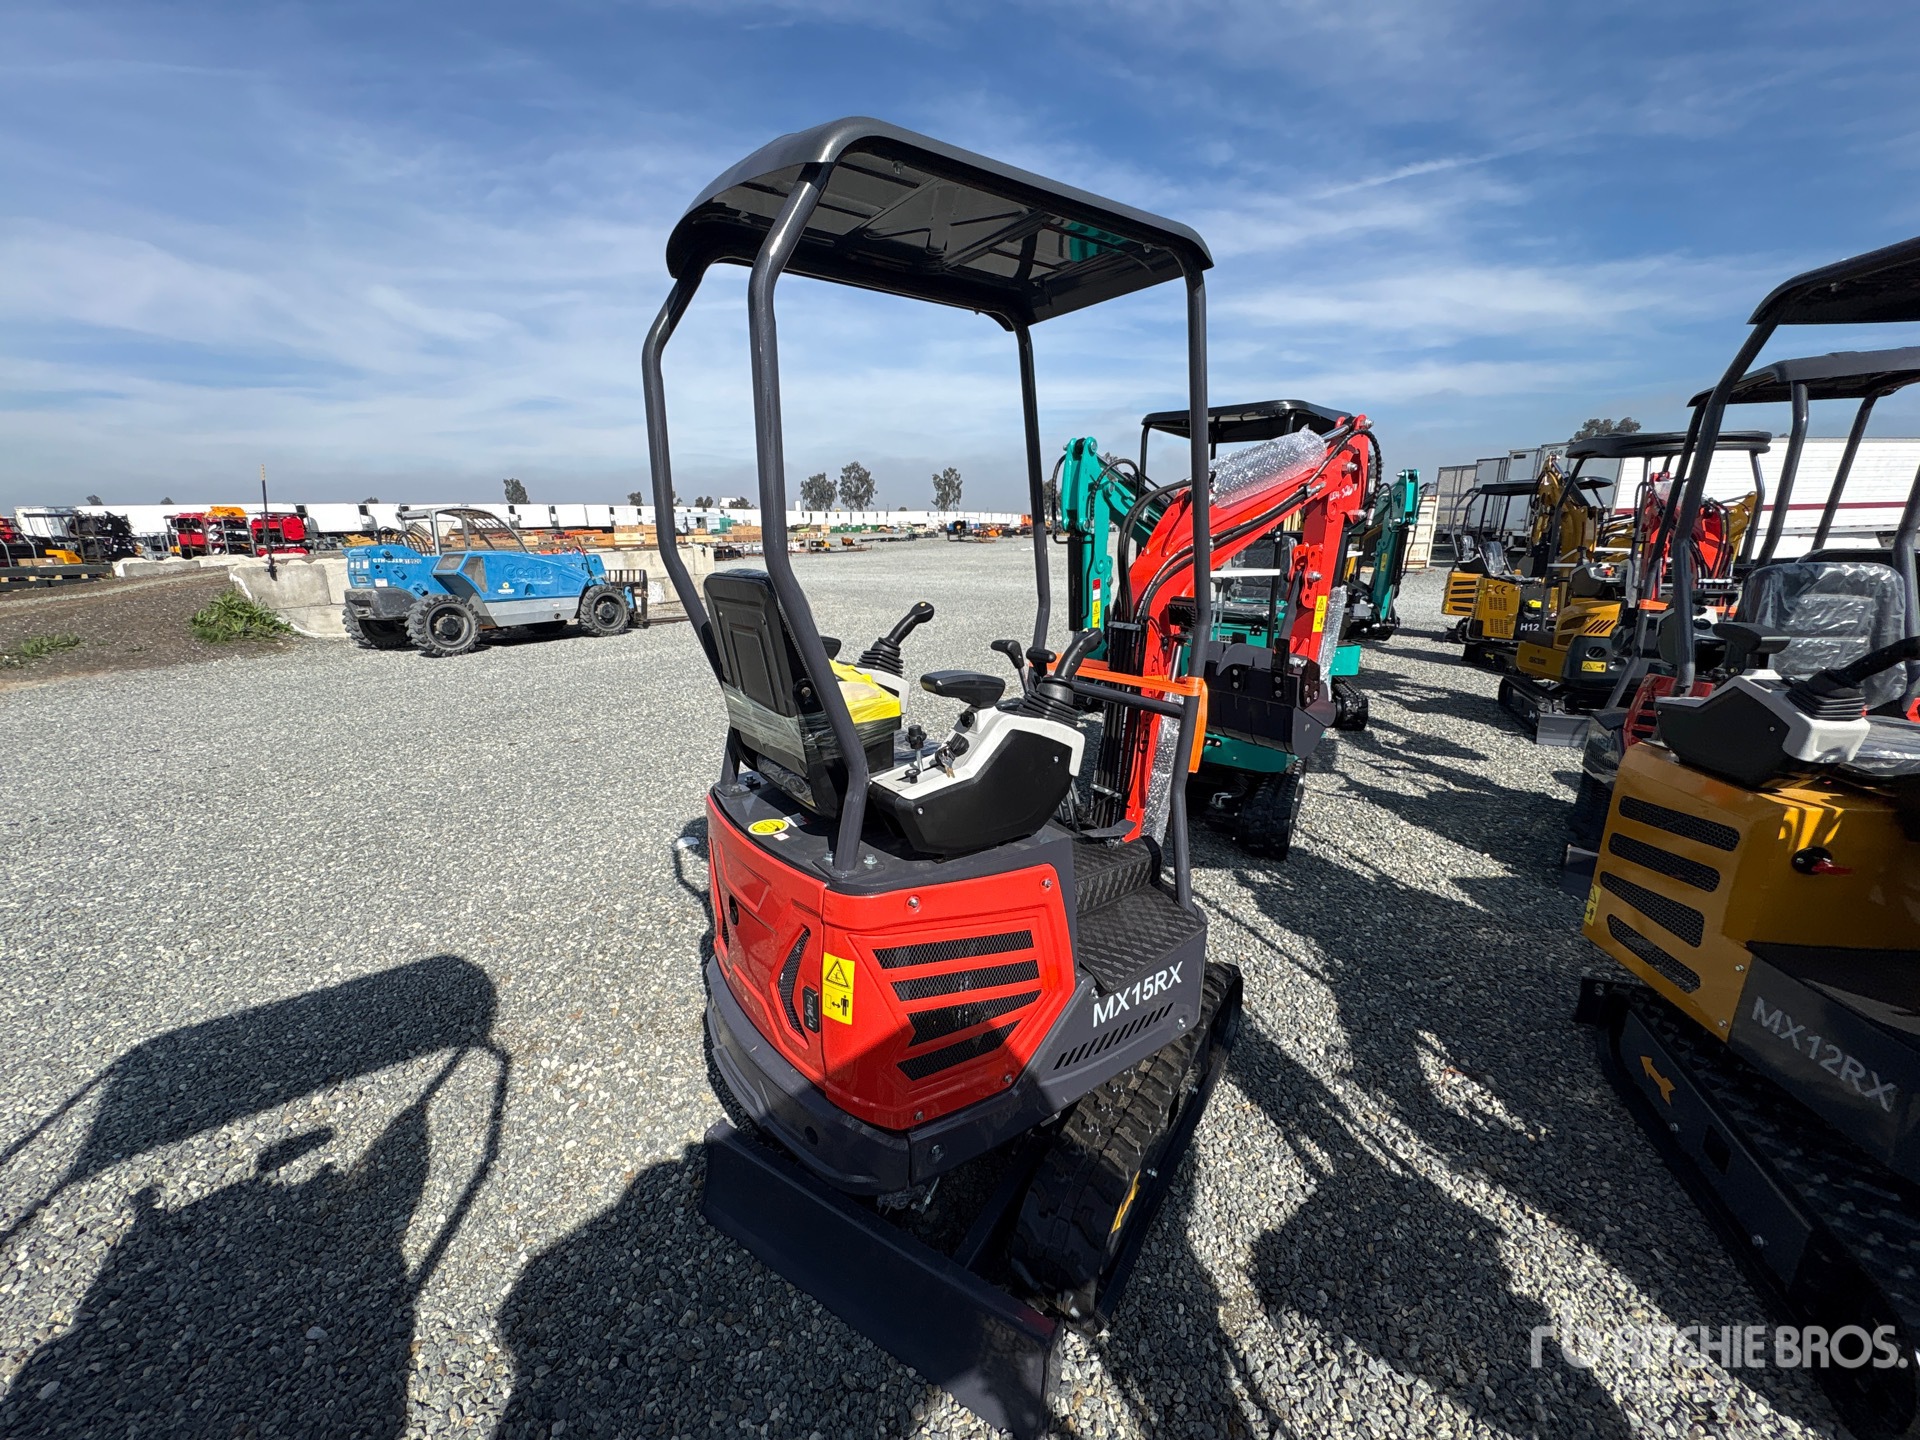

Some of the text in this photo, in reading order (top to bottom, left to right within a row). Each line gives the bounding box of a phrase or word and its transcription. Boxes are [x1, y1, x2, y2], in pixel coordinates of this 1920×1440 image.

[503, 564, 553, 580] Genie
[1093, 961, 1183, 1028] MX15RX
[1752, 996, 1896, 1113] MX12RX
